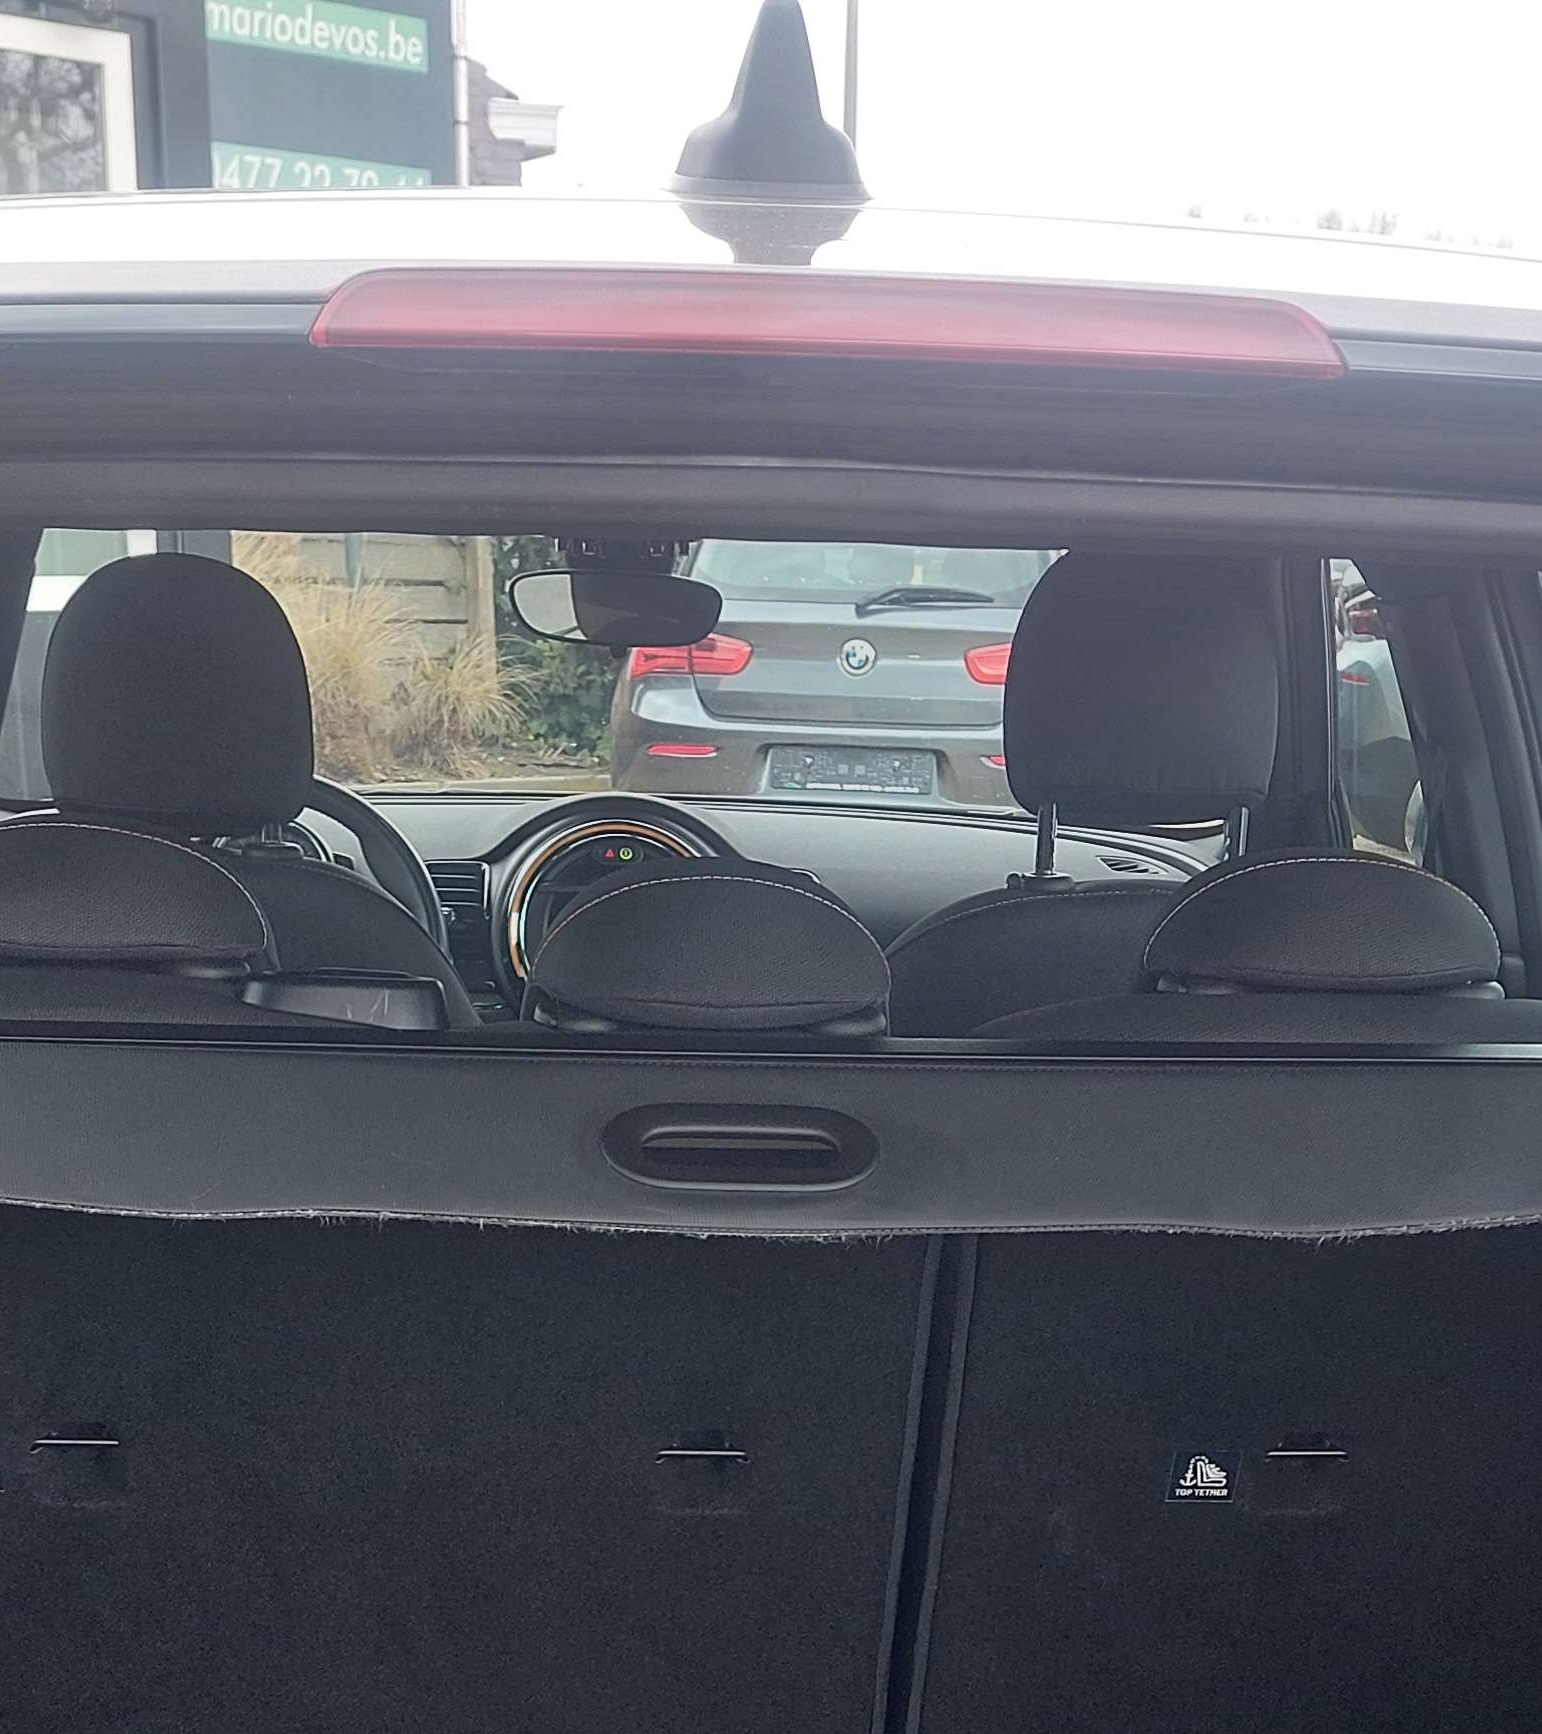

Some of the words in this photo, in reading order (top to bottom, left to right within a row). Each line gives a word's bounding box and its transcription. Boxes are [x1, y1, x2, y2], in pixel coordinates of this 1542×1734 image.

[205, 0, 424, 65] mariodevos.be
[1175, 1488, 1193, 1497] TOP
[1194, 1488, 1228, 1497] TETHER
